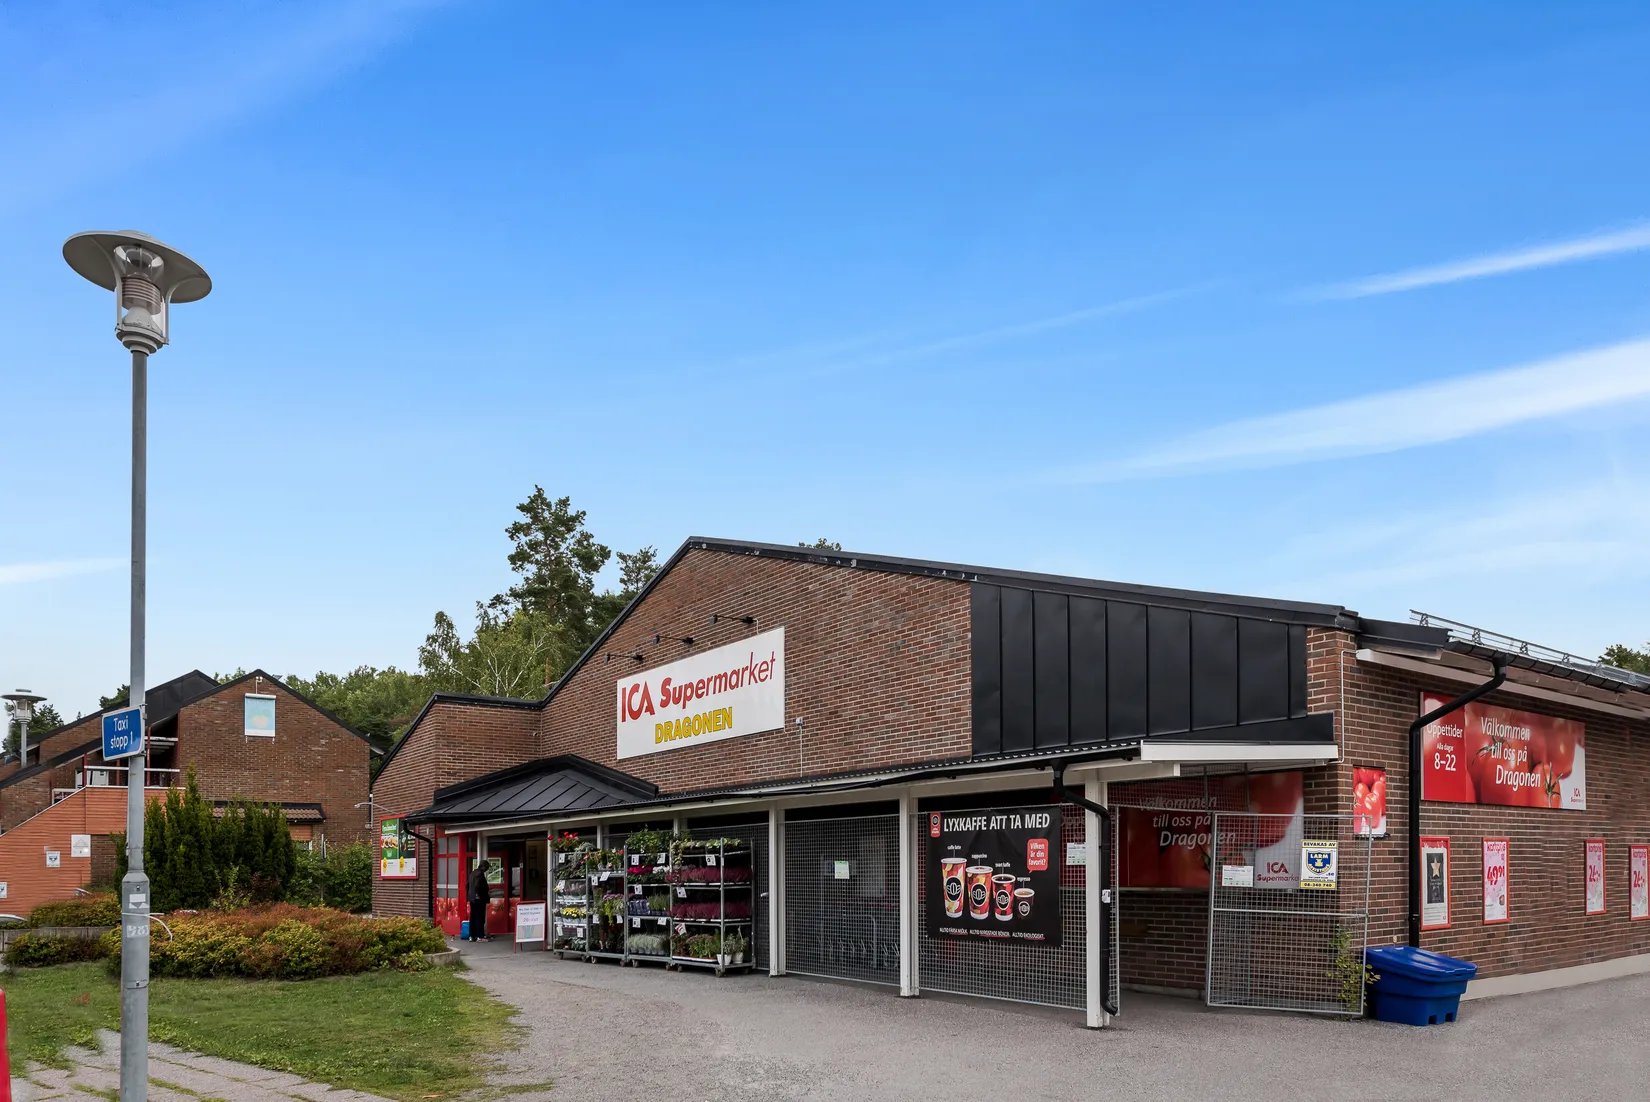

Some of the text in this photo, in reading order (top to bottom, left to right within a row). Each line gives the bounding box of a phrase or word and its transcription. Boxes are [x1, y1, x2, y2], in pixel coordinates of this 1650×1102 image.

[621, 651, 776, 723] ICA Supermarket
[113, 715, 129, 732] Taxi
[655, 706, 733, 744] DRAGONEN
[1481, 716, 1531, 741] Välkommen
[110, 735, 128, 750] stopp
[1491, 742, 1528, 766] till oss på
[1495, 764, 1541, 792] Dragonen
[943, 816, 987, 832] LYXKAFFE
[989, 815, 1007, 830] ATT
[1009, 815, 1022, 829] TA
[1024, 813, 1050, 829] MED
[1152, 812, 1211, 829] till oss på
[1030, 842, 1045, 850] Vilken
[1266, 862, 1289, 873] ICA
